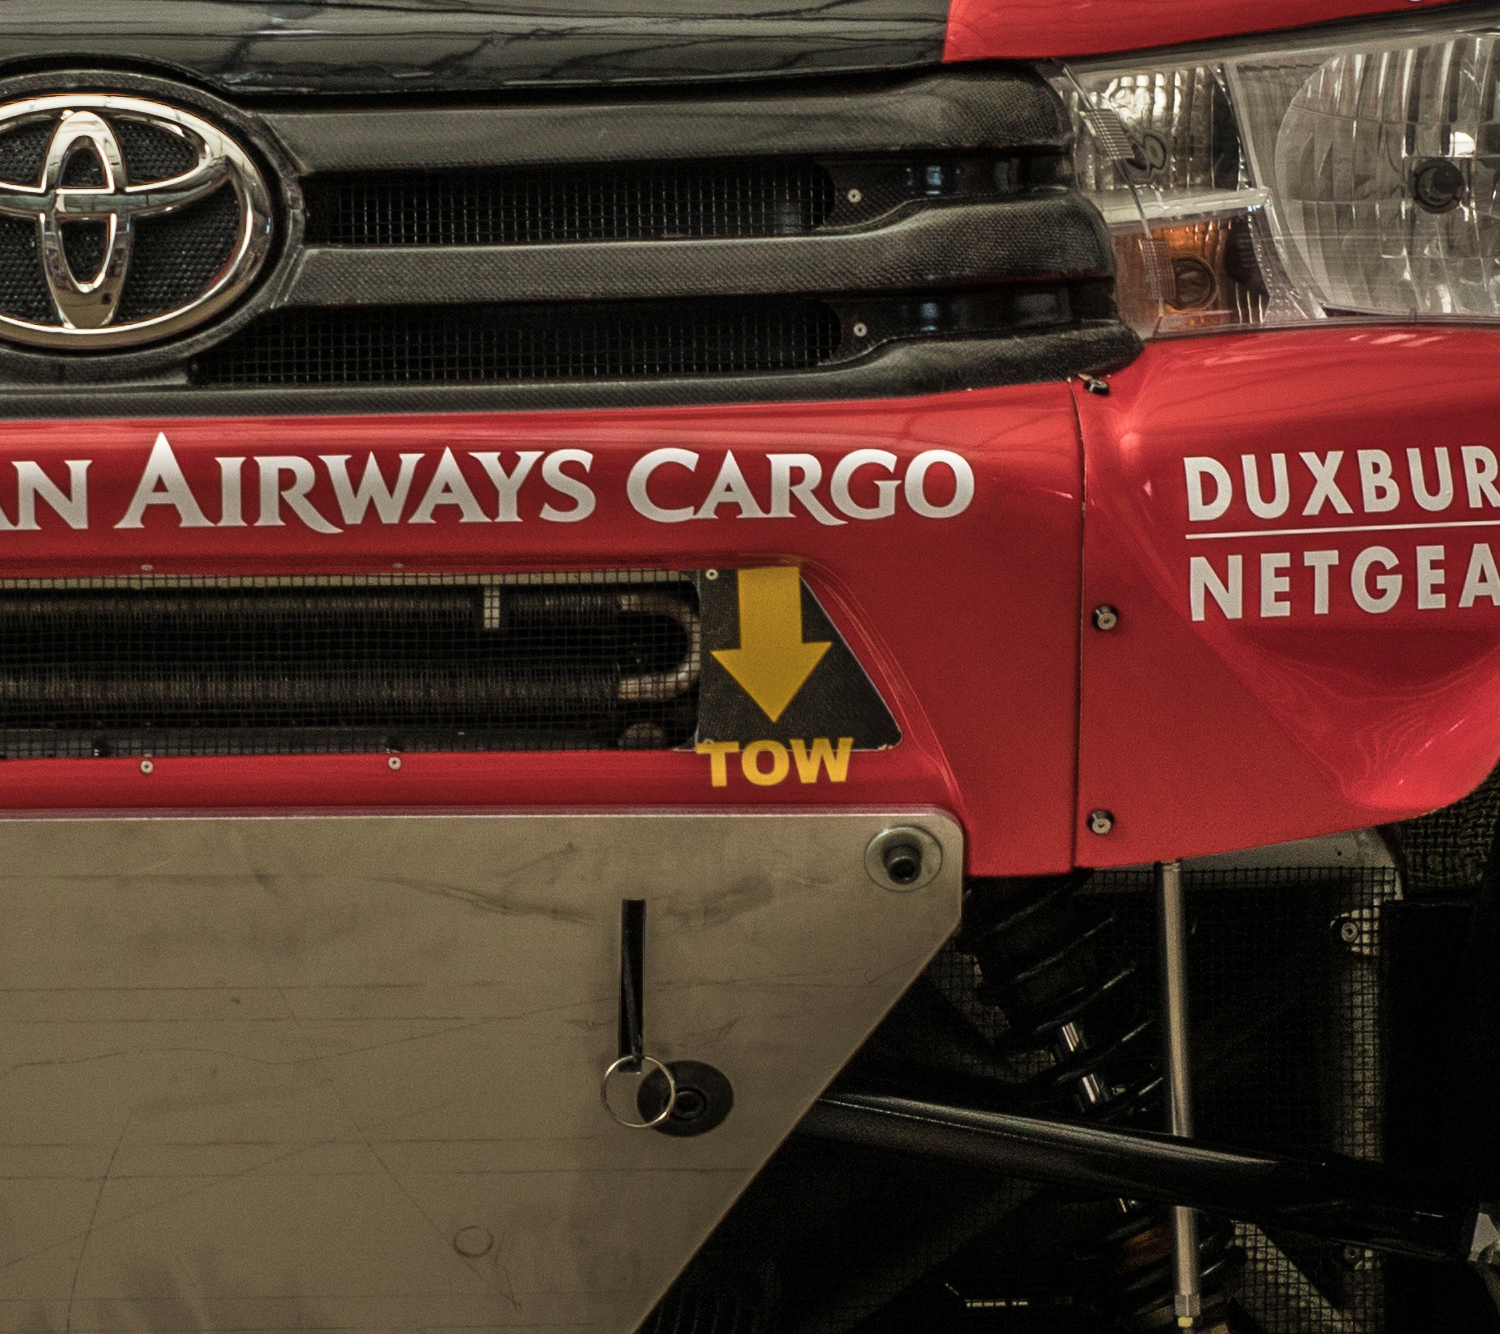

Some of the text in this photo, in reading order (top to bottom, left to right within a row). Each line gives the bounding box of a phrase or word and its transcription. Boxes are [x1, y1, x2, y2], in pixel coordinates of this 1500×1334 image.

[113, 431, 596, 534] AIRWAYS
[626, 447, 975, 526] CARGO
[695, 737, 854, 787] TOW
